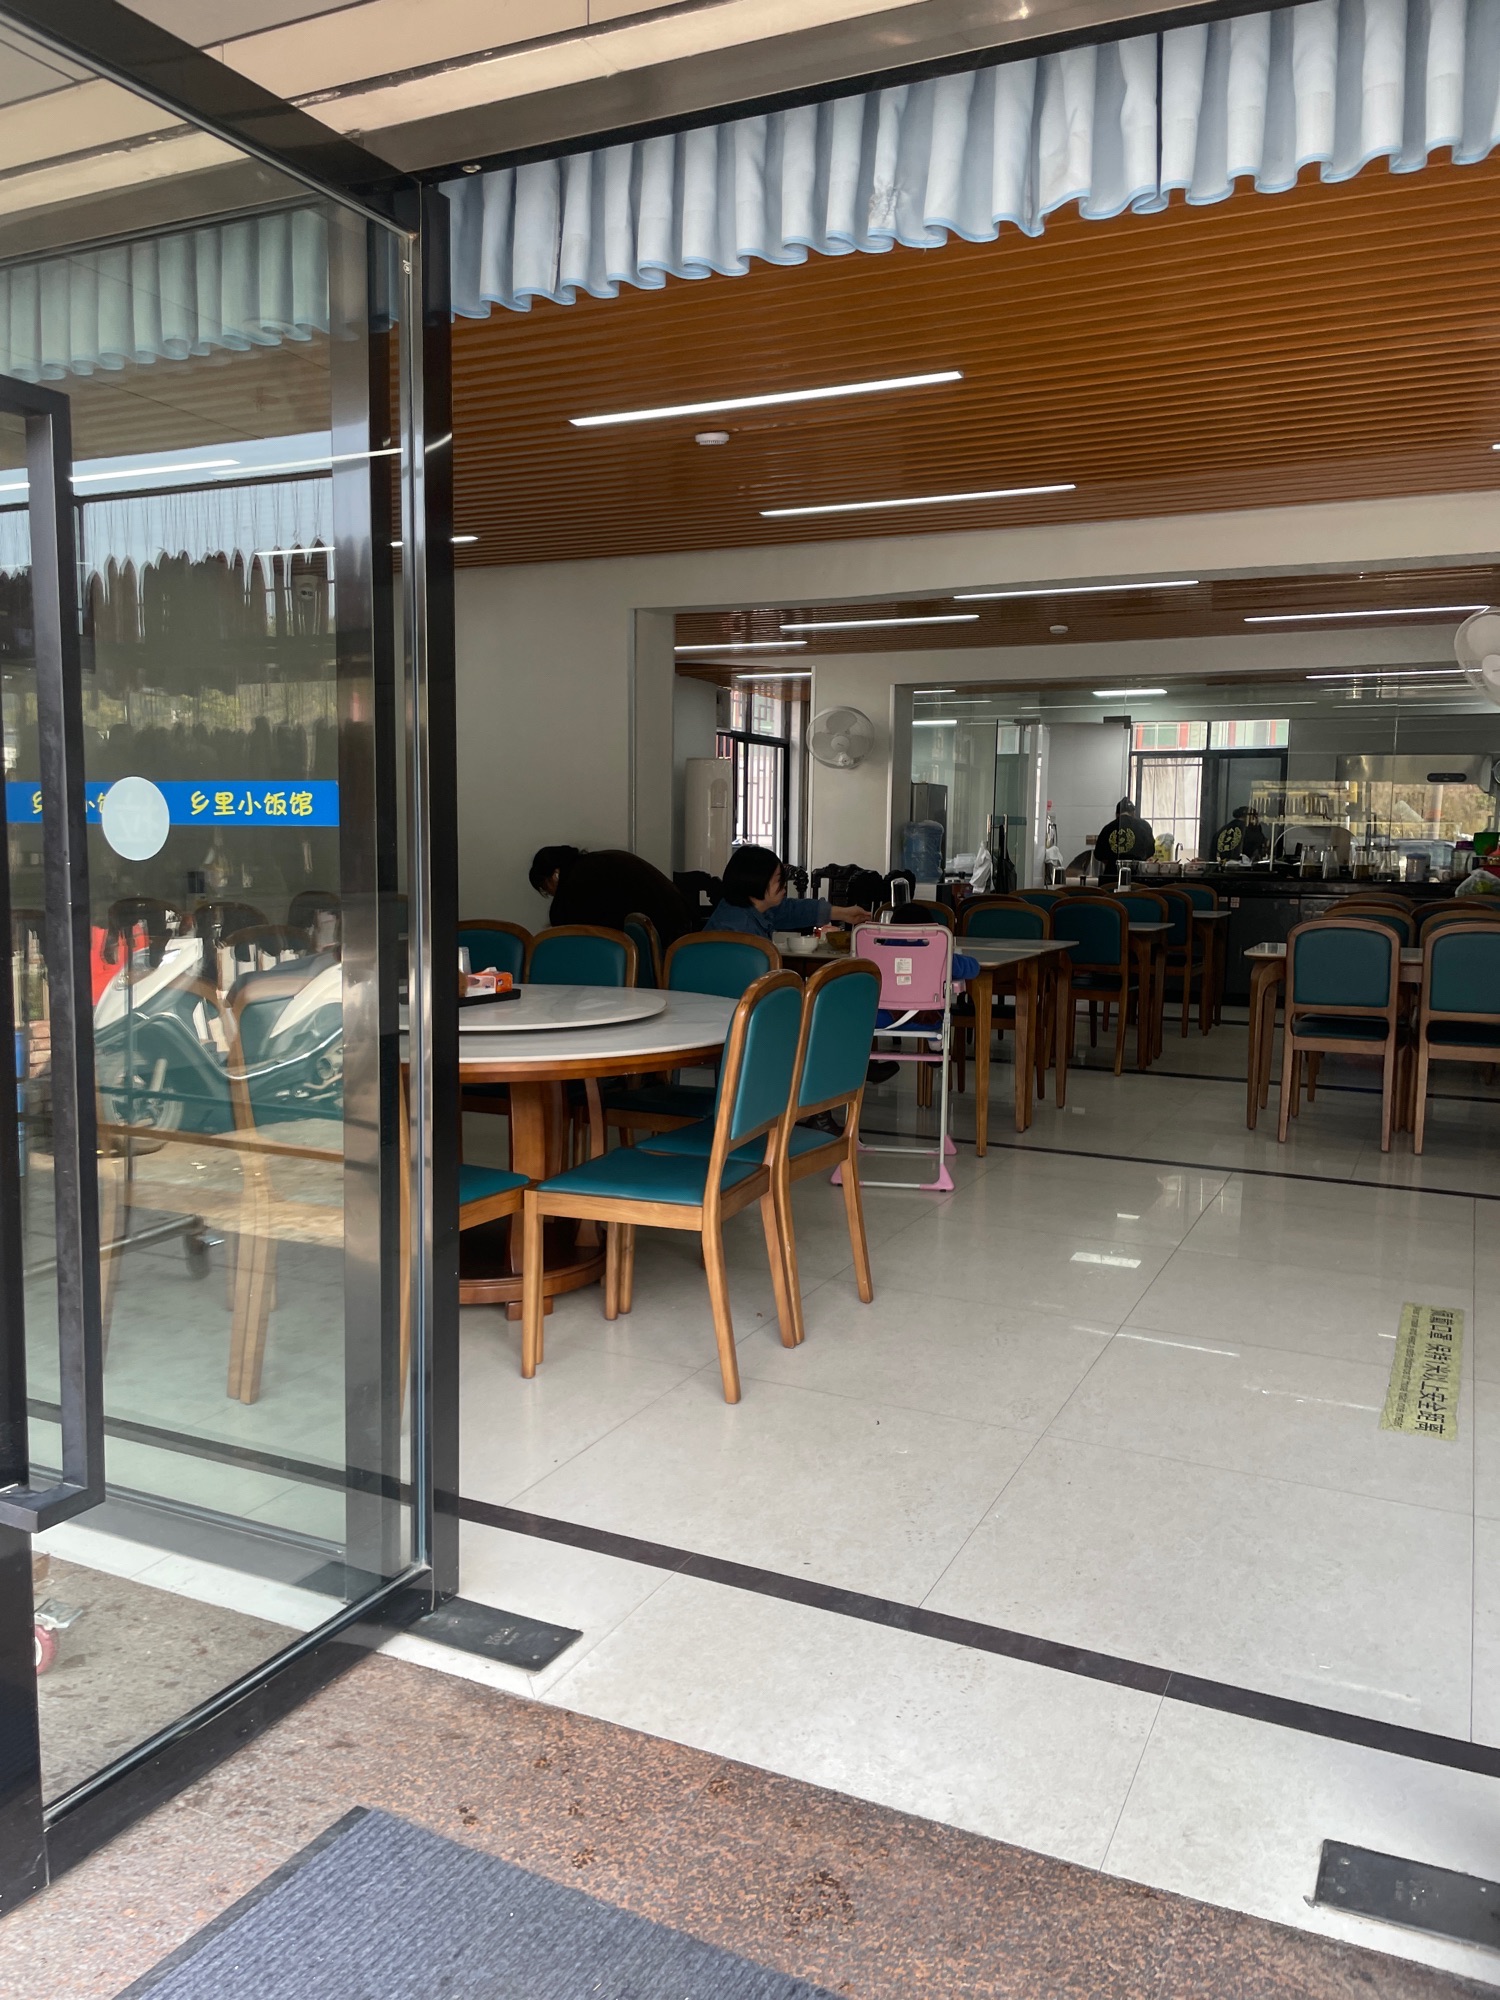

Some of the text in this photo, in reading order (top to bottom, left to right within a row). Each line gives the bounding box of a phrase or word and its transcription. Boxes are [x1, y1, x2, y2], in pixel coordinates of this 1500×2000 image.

[190, 790, 313, 816] 乡里小饭馆
